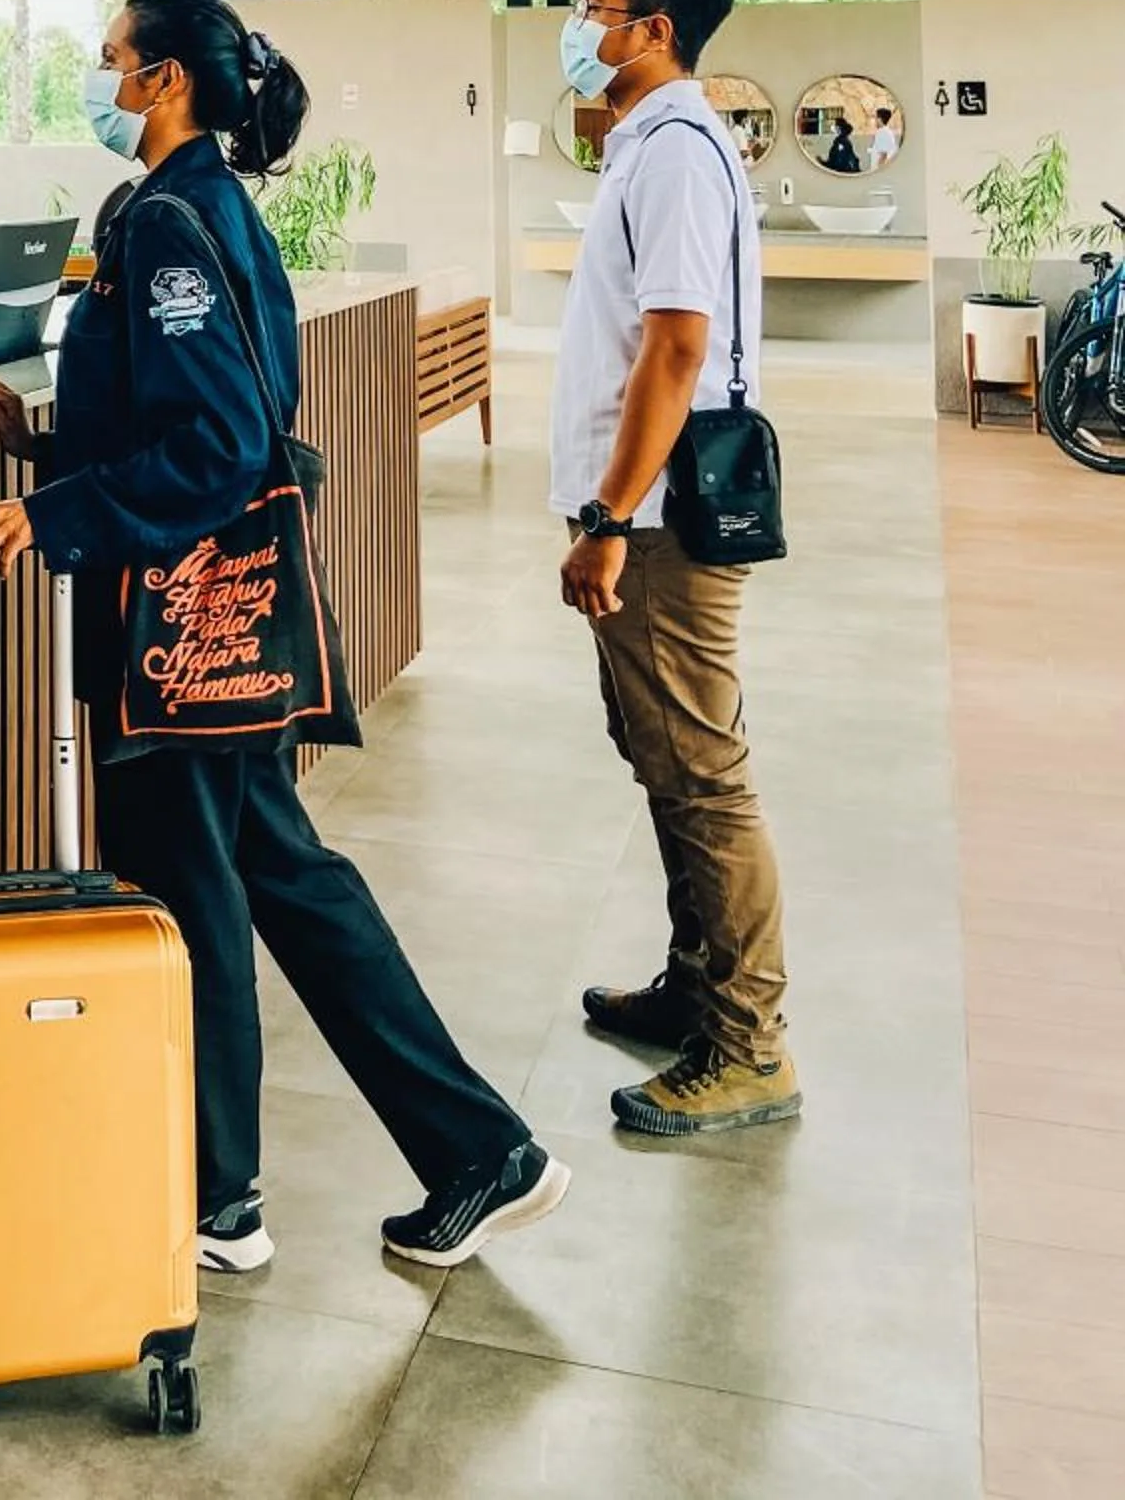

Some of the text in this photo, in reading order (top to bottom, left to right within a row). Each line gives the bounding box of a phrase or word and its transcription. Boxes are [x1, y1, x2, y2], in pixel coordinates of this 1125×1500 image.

[94, 281, 115, 296] 17
[179, 603, 272, 642] Pada
[160, 671, 294, 714] Hammu
